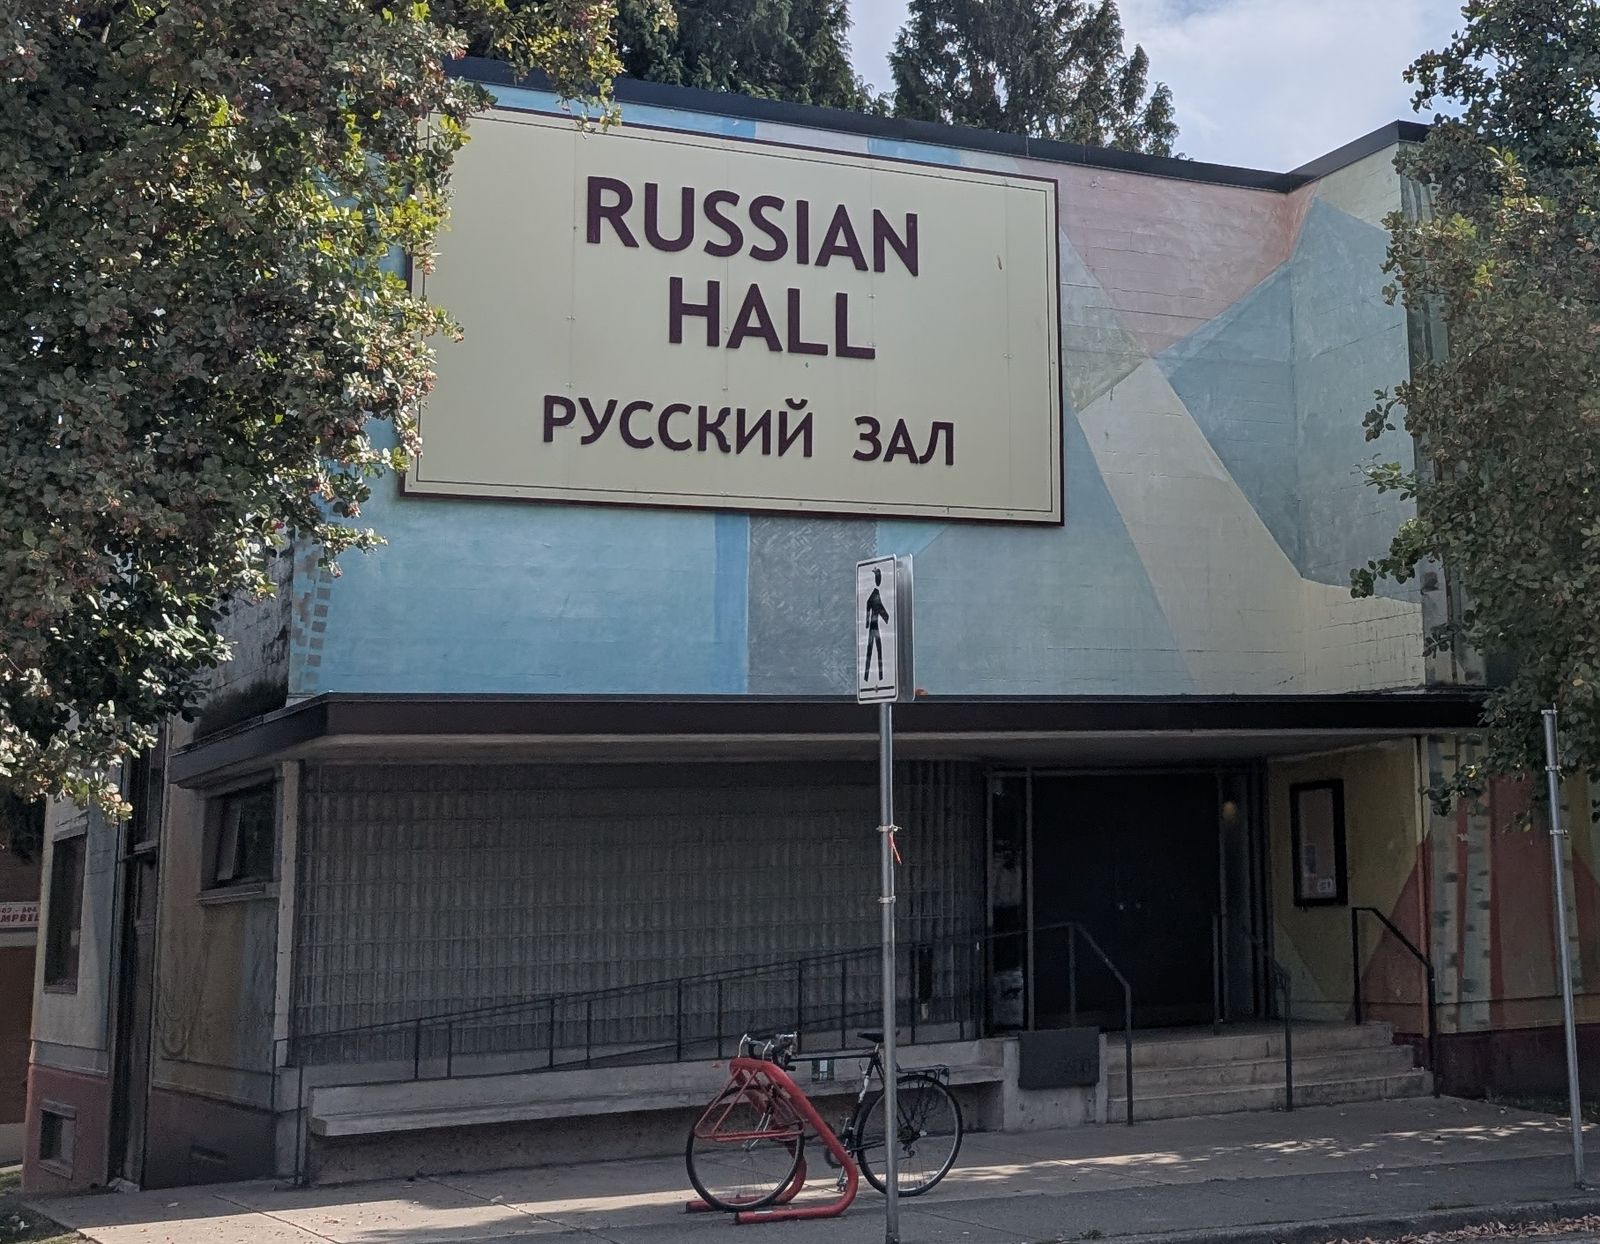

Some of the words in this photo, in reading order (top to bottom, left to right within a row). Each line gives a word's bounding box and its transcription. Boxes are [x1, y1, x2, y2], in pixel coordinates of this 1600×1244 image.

[586, 175, 919, 278] RUSSIAN
[668, 276, 876, 360] HALL
[542, 394, 814, 459] РУССКИЙ
[852, 415, 955, 467] ЗАЛ
